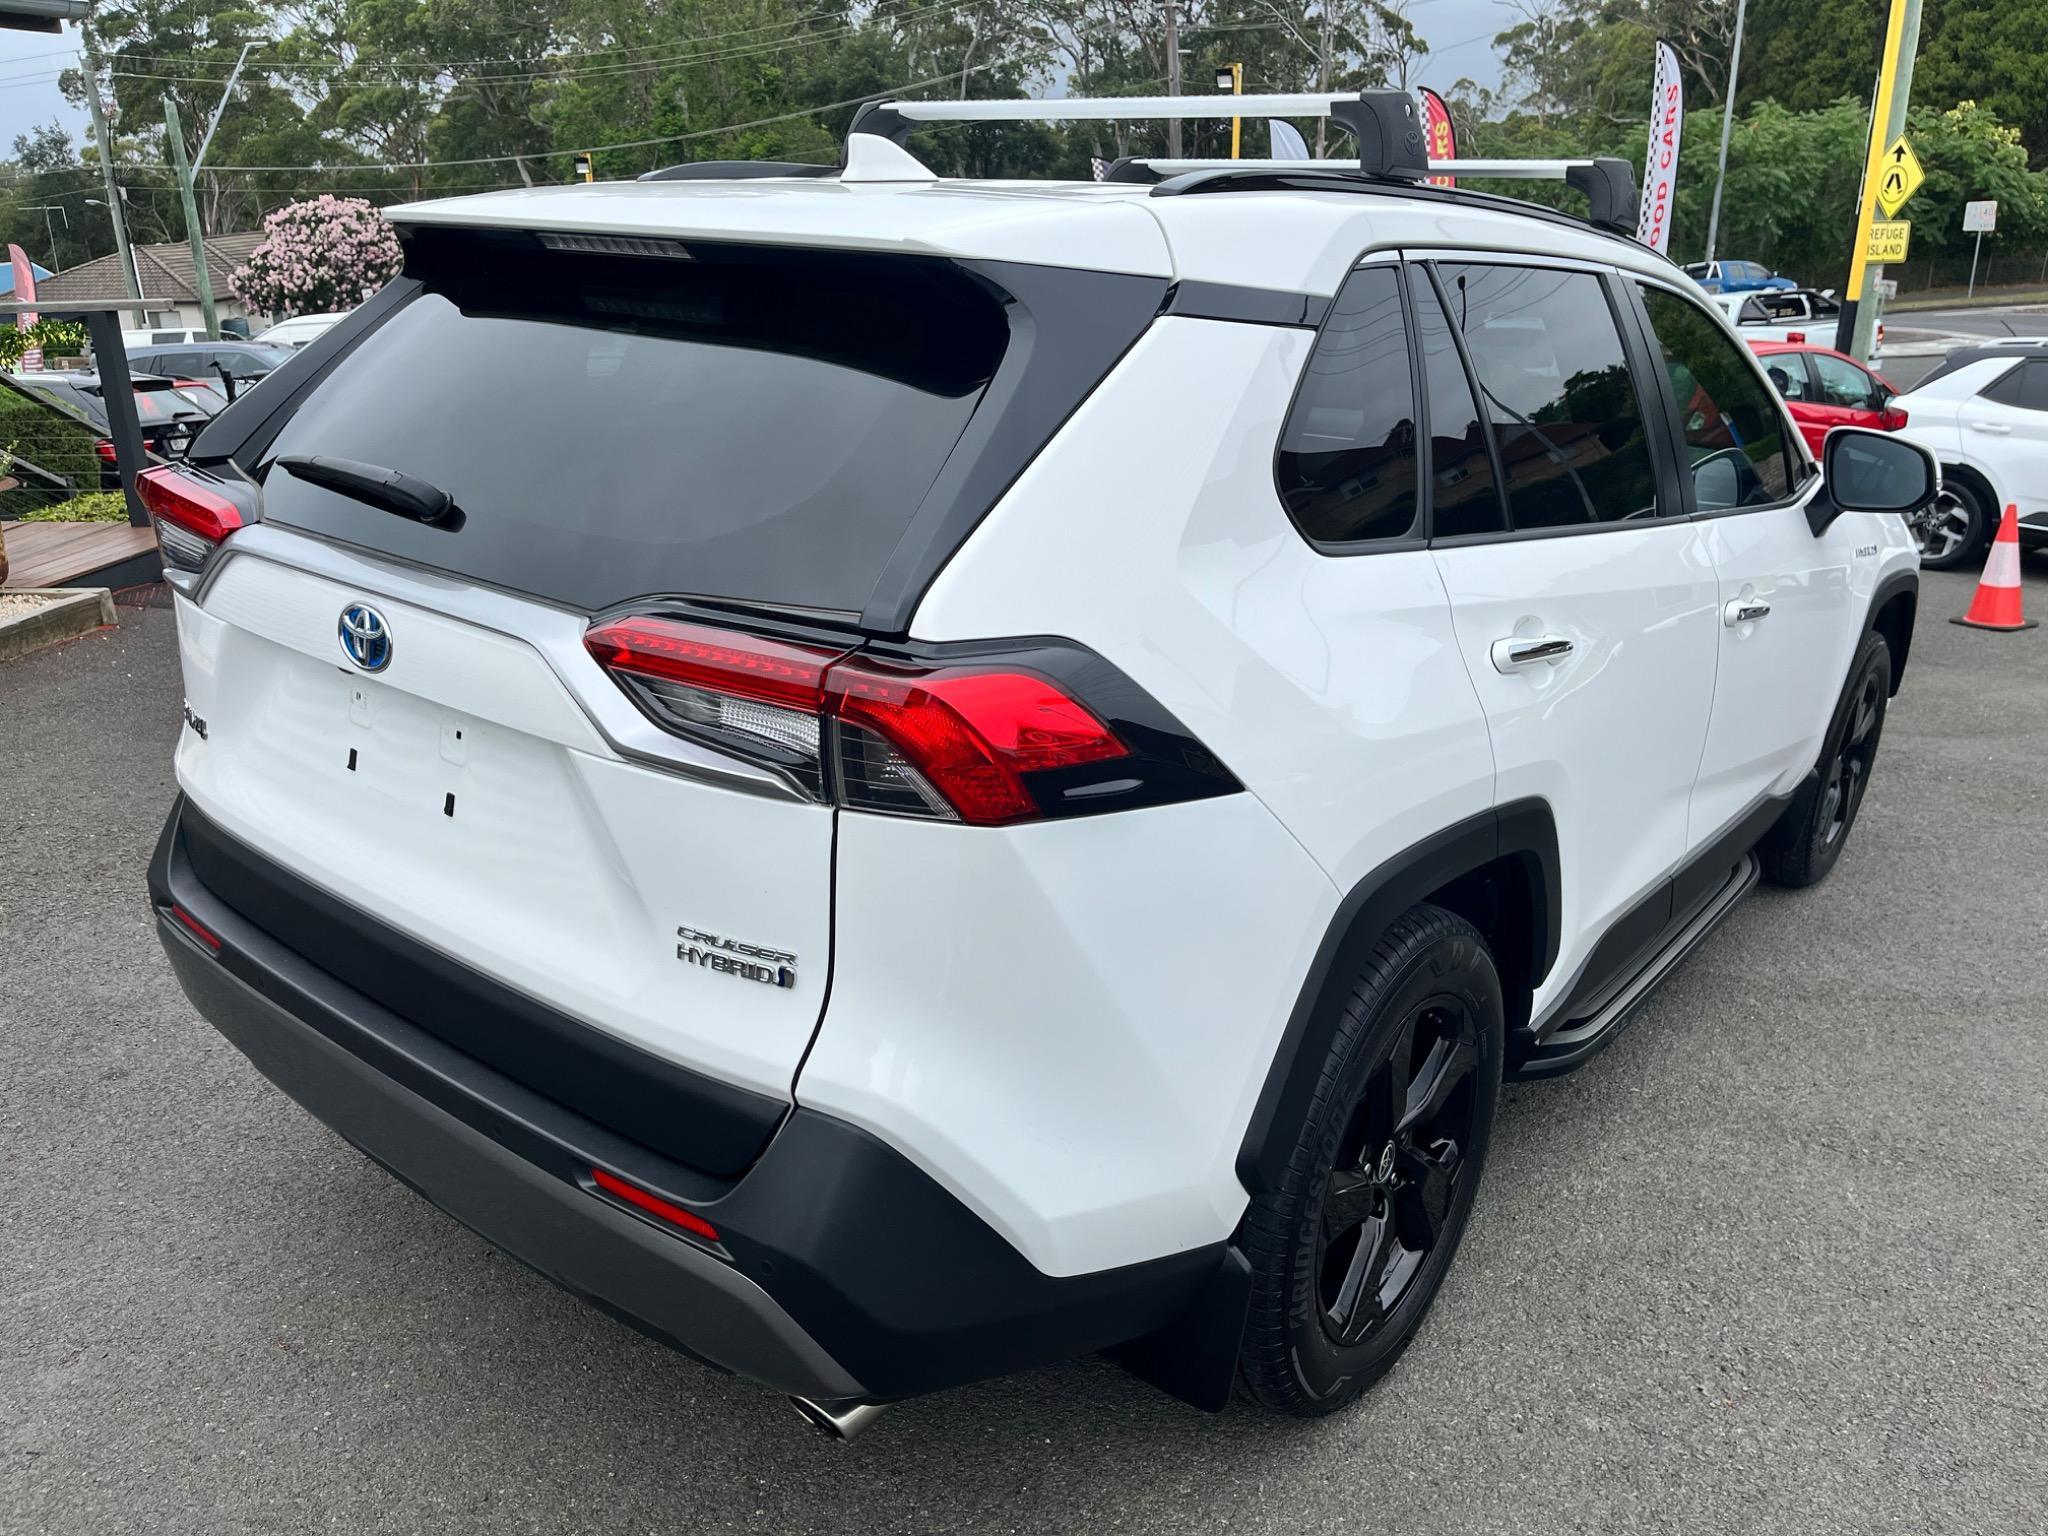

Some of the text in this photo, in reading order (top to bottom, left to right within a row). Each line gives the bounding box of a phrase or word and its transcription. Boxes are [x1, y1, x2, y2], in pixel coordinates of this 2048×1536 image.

[1434, 120, 1449, 187] CRS
[1650, 83, 1679, 247] OOD CARS
[1866, 243, 1902, 256] ISLAND
[676, 924, 798, 967] CRUISER
[676, 942, 774, 984] HYBRID
